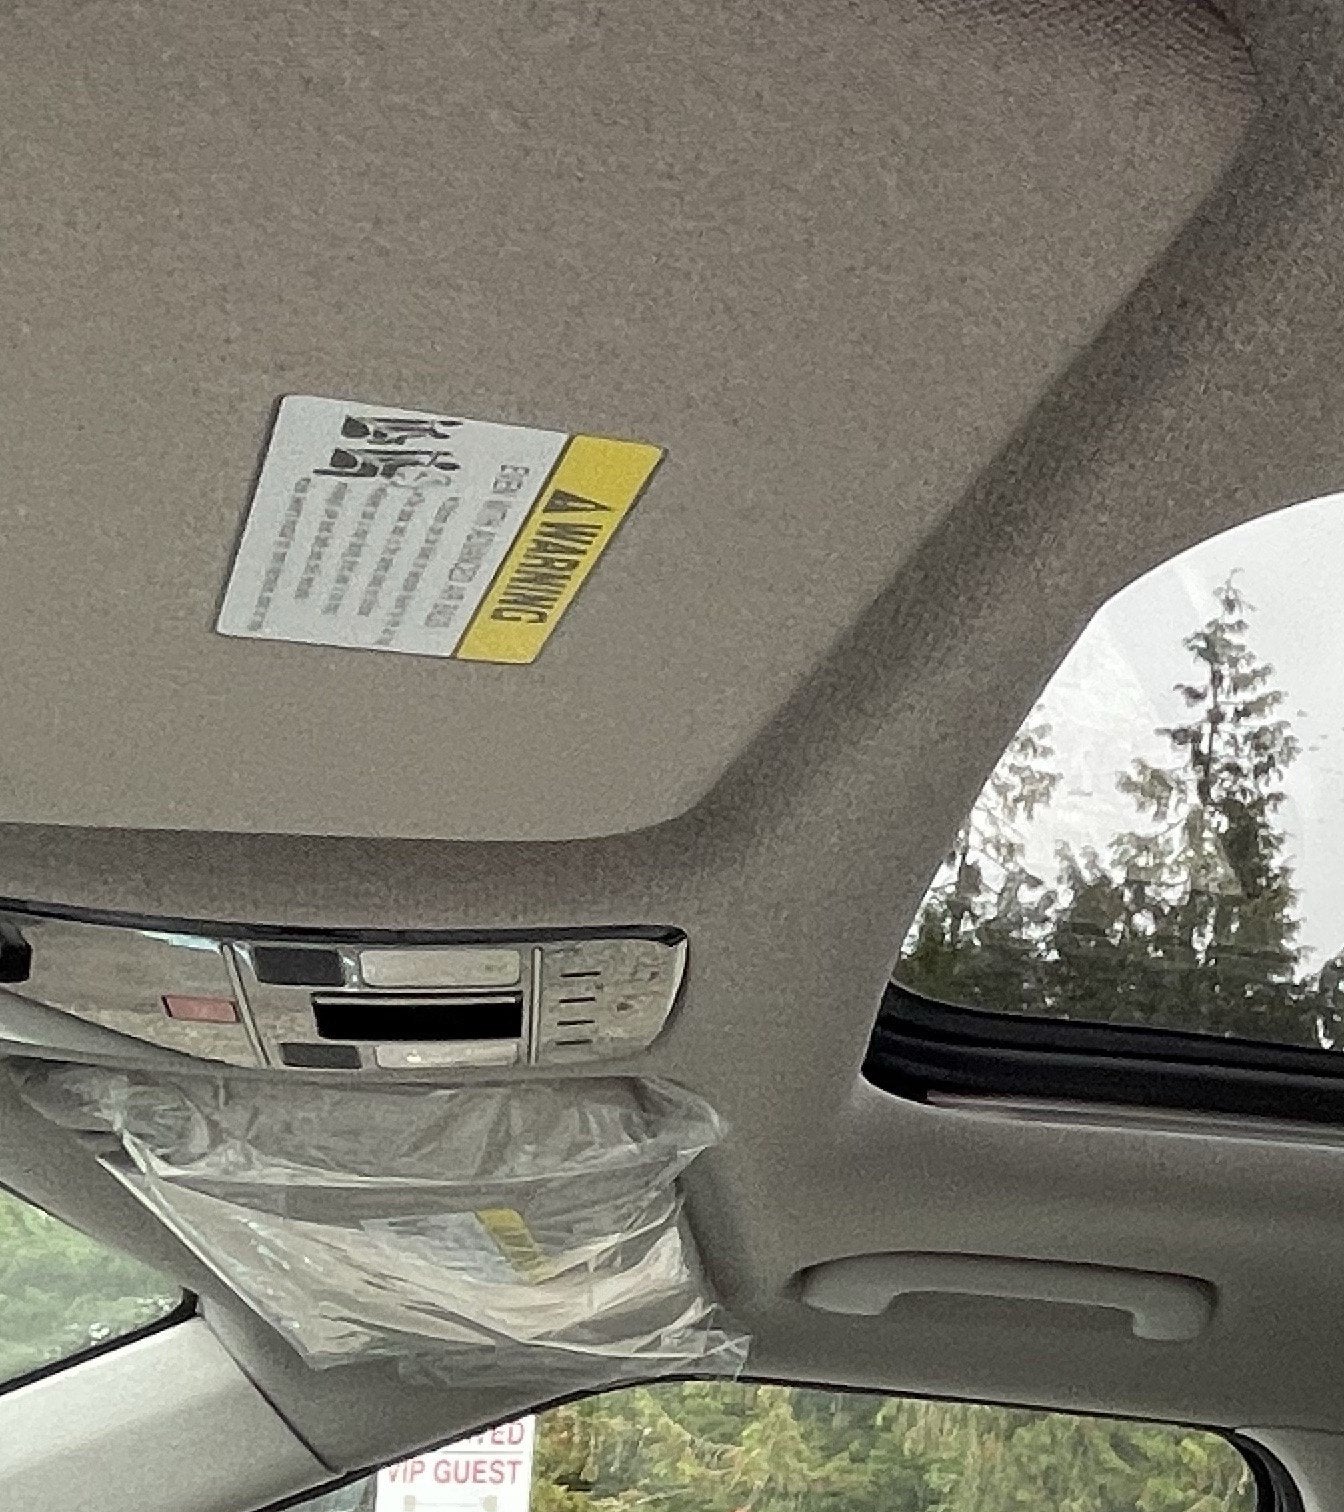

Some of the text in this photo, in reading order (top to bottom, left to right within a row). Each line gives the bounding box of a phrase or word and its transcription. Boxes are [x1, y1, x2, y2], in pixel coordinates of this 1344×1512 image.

[490, 520, 604, 624] WARNING
[388, 1458, 524, 1485] VIP GUEST
